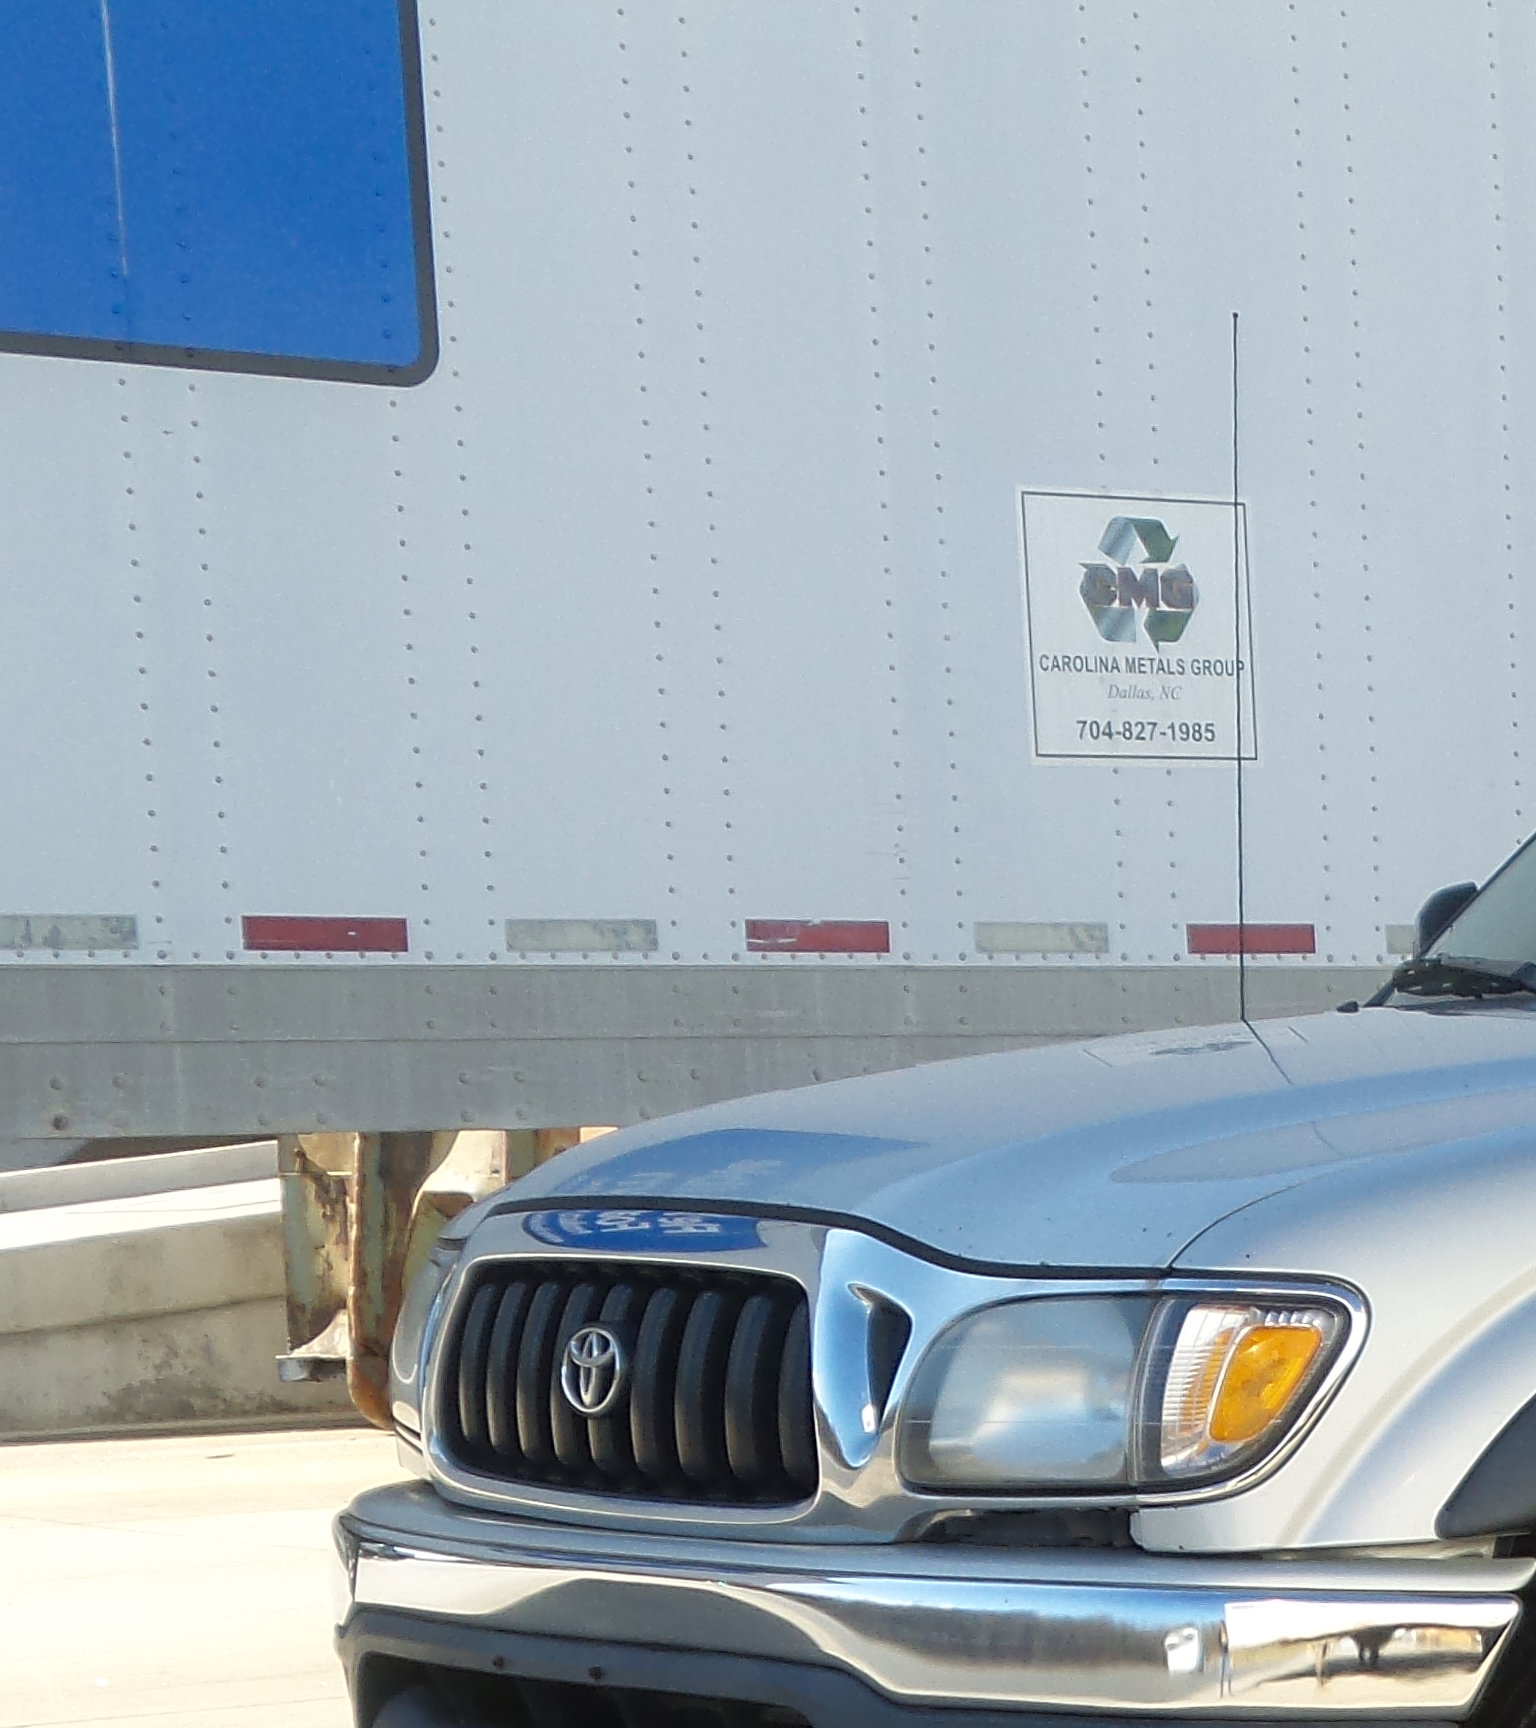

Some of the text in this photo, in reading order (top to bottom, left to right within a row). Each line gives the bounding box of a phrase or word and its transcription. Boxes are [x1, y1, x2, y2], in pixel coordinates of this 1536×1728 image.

[1039, 654, 1245, 677] CAROLINA METALS GROUP
[1107, 684, 1183, 701] Dallas, NC
[1076, 720, 1216, 742] 704-827-1985
